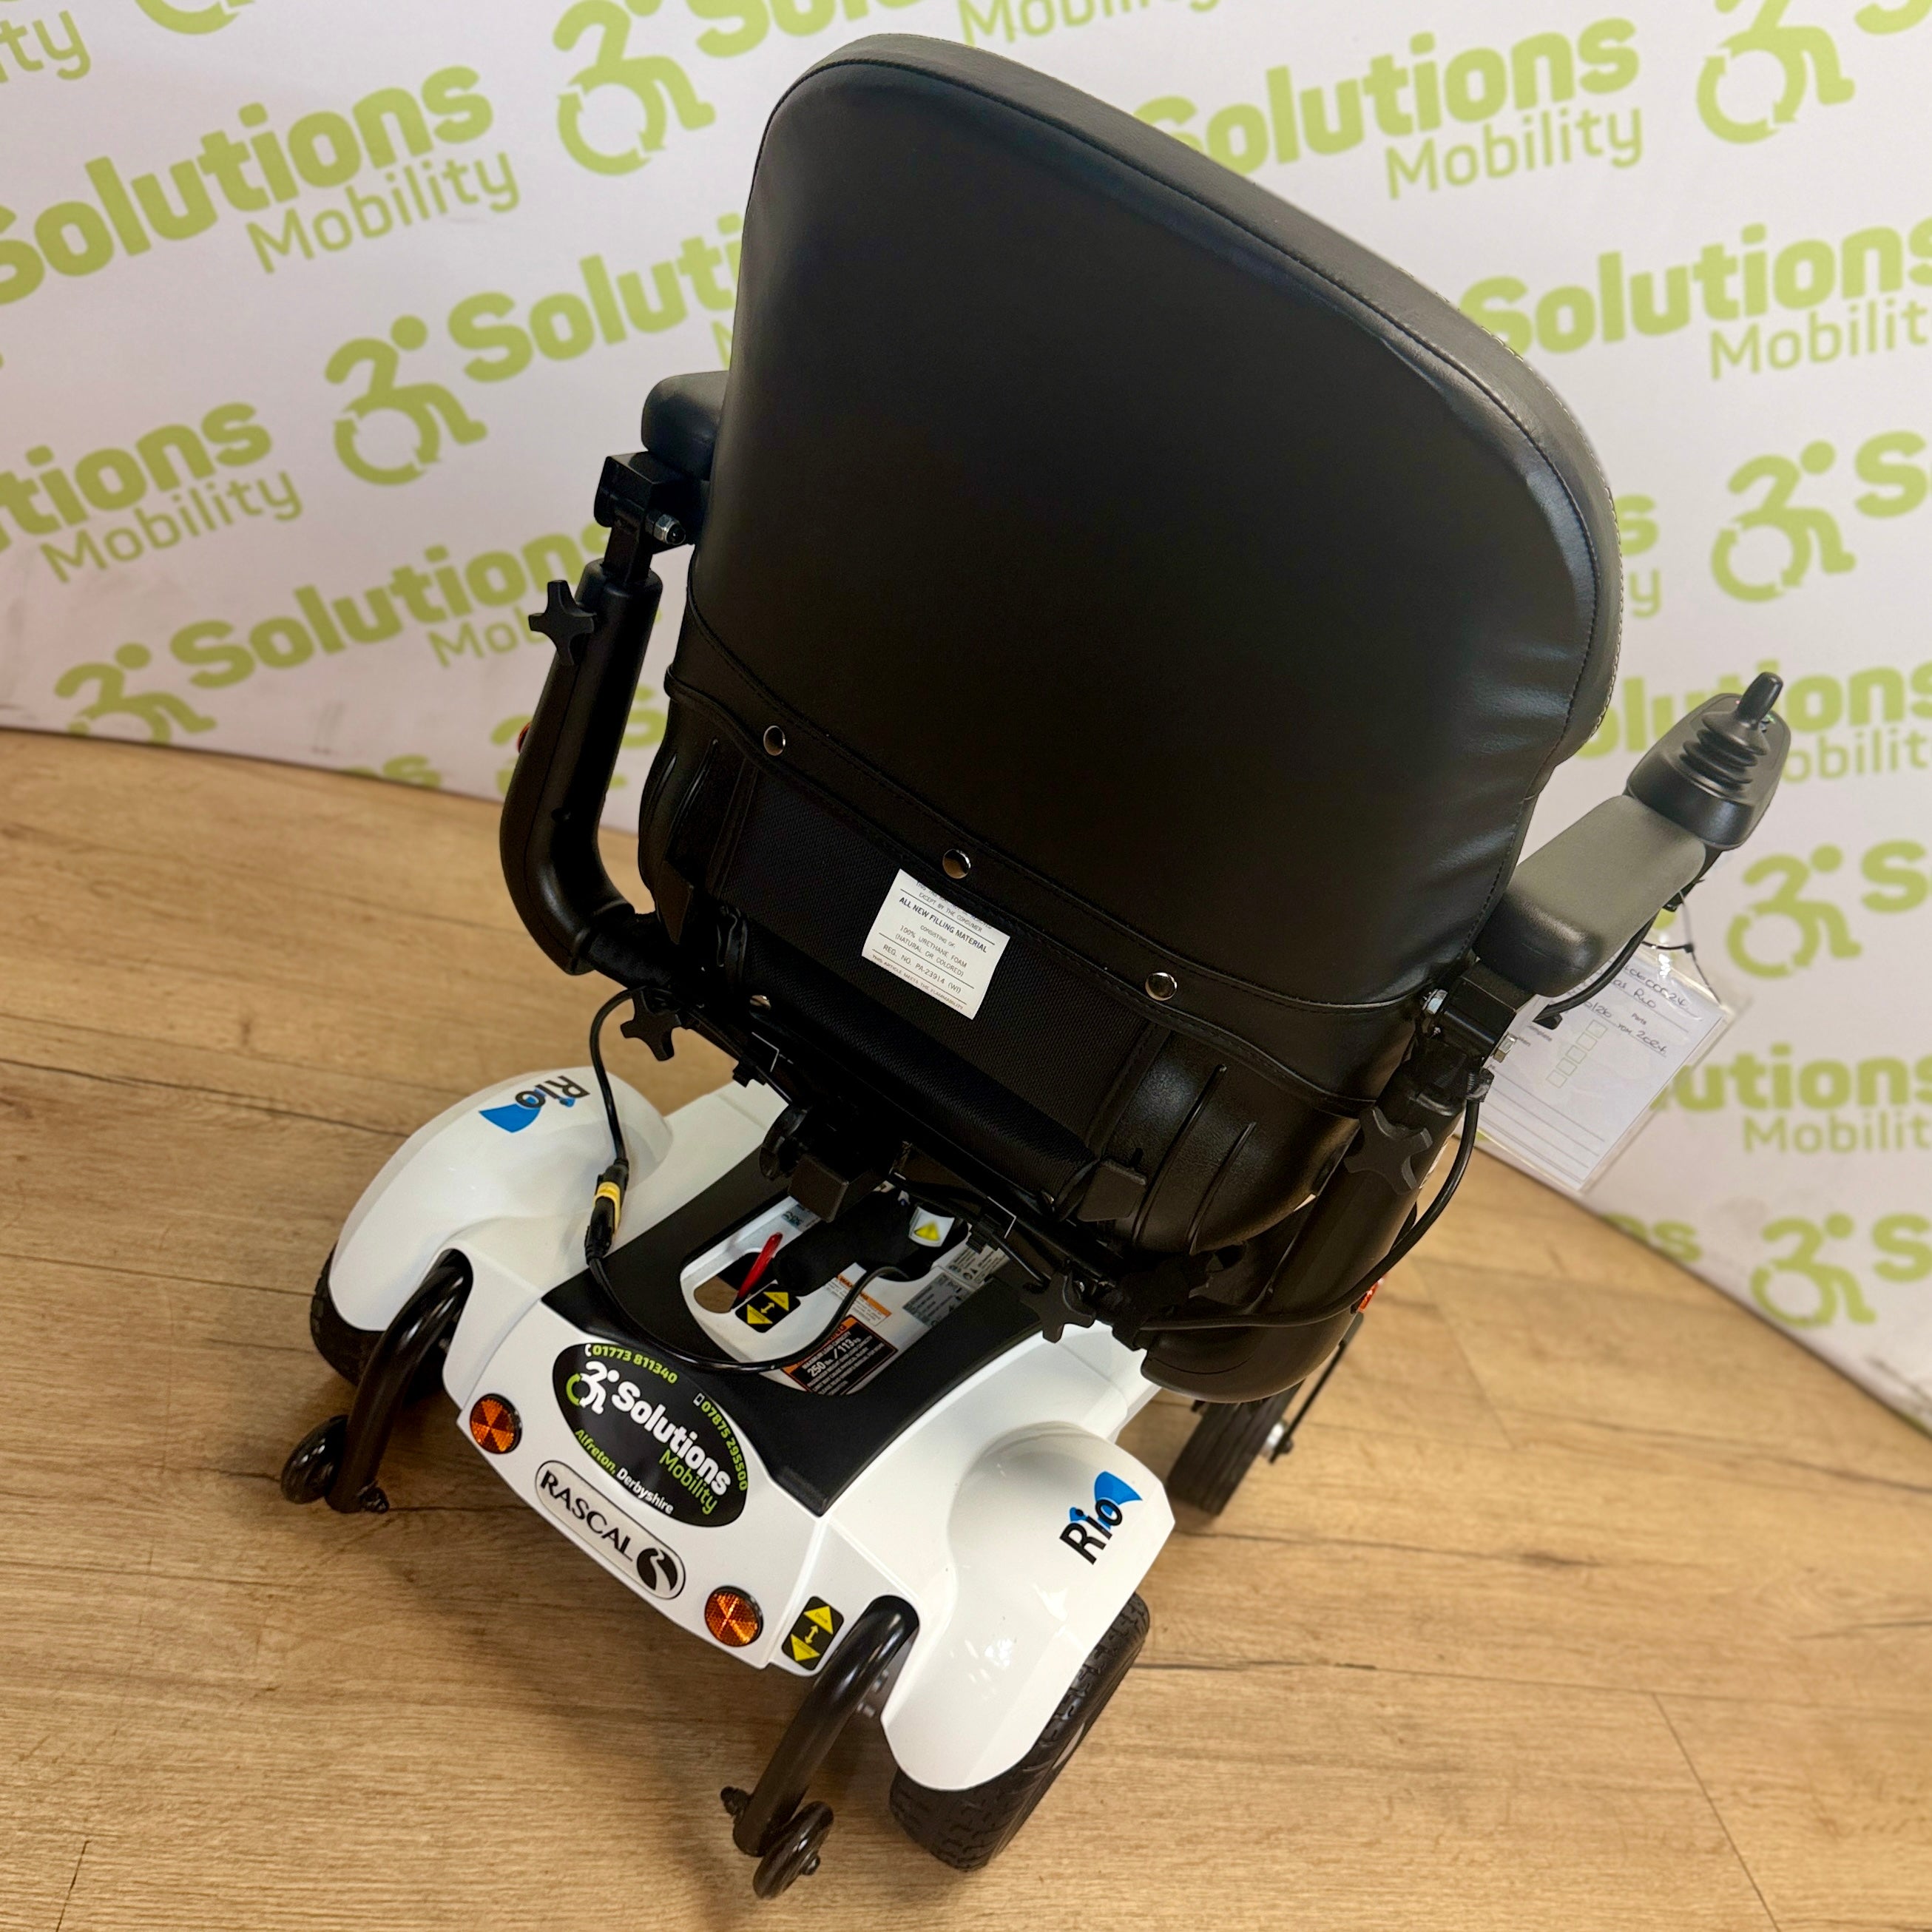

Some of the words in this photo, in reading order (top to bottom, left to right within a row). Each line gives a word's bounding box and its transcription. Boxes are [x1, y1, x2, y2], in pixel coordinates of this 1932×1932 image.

[1385, 107, 1644, 200] Mobility
[246, 151, 519, 274] Mobility
[1710, 297, 1932, 377] Mobilit
[0, 402, 272, 553] tions
[39, 470, 304, 584] Mobility
[899, 896, 911, 908] ALL
[912, 904, 929, 918] NEW
[929, 914, 954, 933] FILLING
[955, 929, 987, 953] MATERIAL
[899, 925, 916, 938] 100%
[918, 936, 950, 956] URETHANE
[950, 954, 967, 968] FOAM
[882, 944, 897, 956] REG.
[901, 954, 912, 965] NO.
[915, 963, 945, 984] PA-23914
[895, 933, 922, 953] (NATURAL
[925, 950, 934, 959] OR
[936, 956, 965, 977] COLORED)
[1631, 1013, 1647, 1025] Parts
[515, 1075, 591, 1109] Rio
[1741, 1109, 1932, 1154] Mobilit
[592, 1343, 632, 1362] 01773
[632, 1354, 678, 1384] 811340
[611, 1379, 732, 1496] Solutions
[700, 1400, 731, 1439] 07875
[615, 1467, 675, 1516] Derbyshire
[659, 1448, 718, 1516] Mobility
[539, 1469, 634, 1563] RASCAL
[1058, 1498, 1124, 1566] Rio
